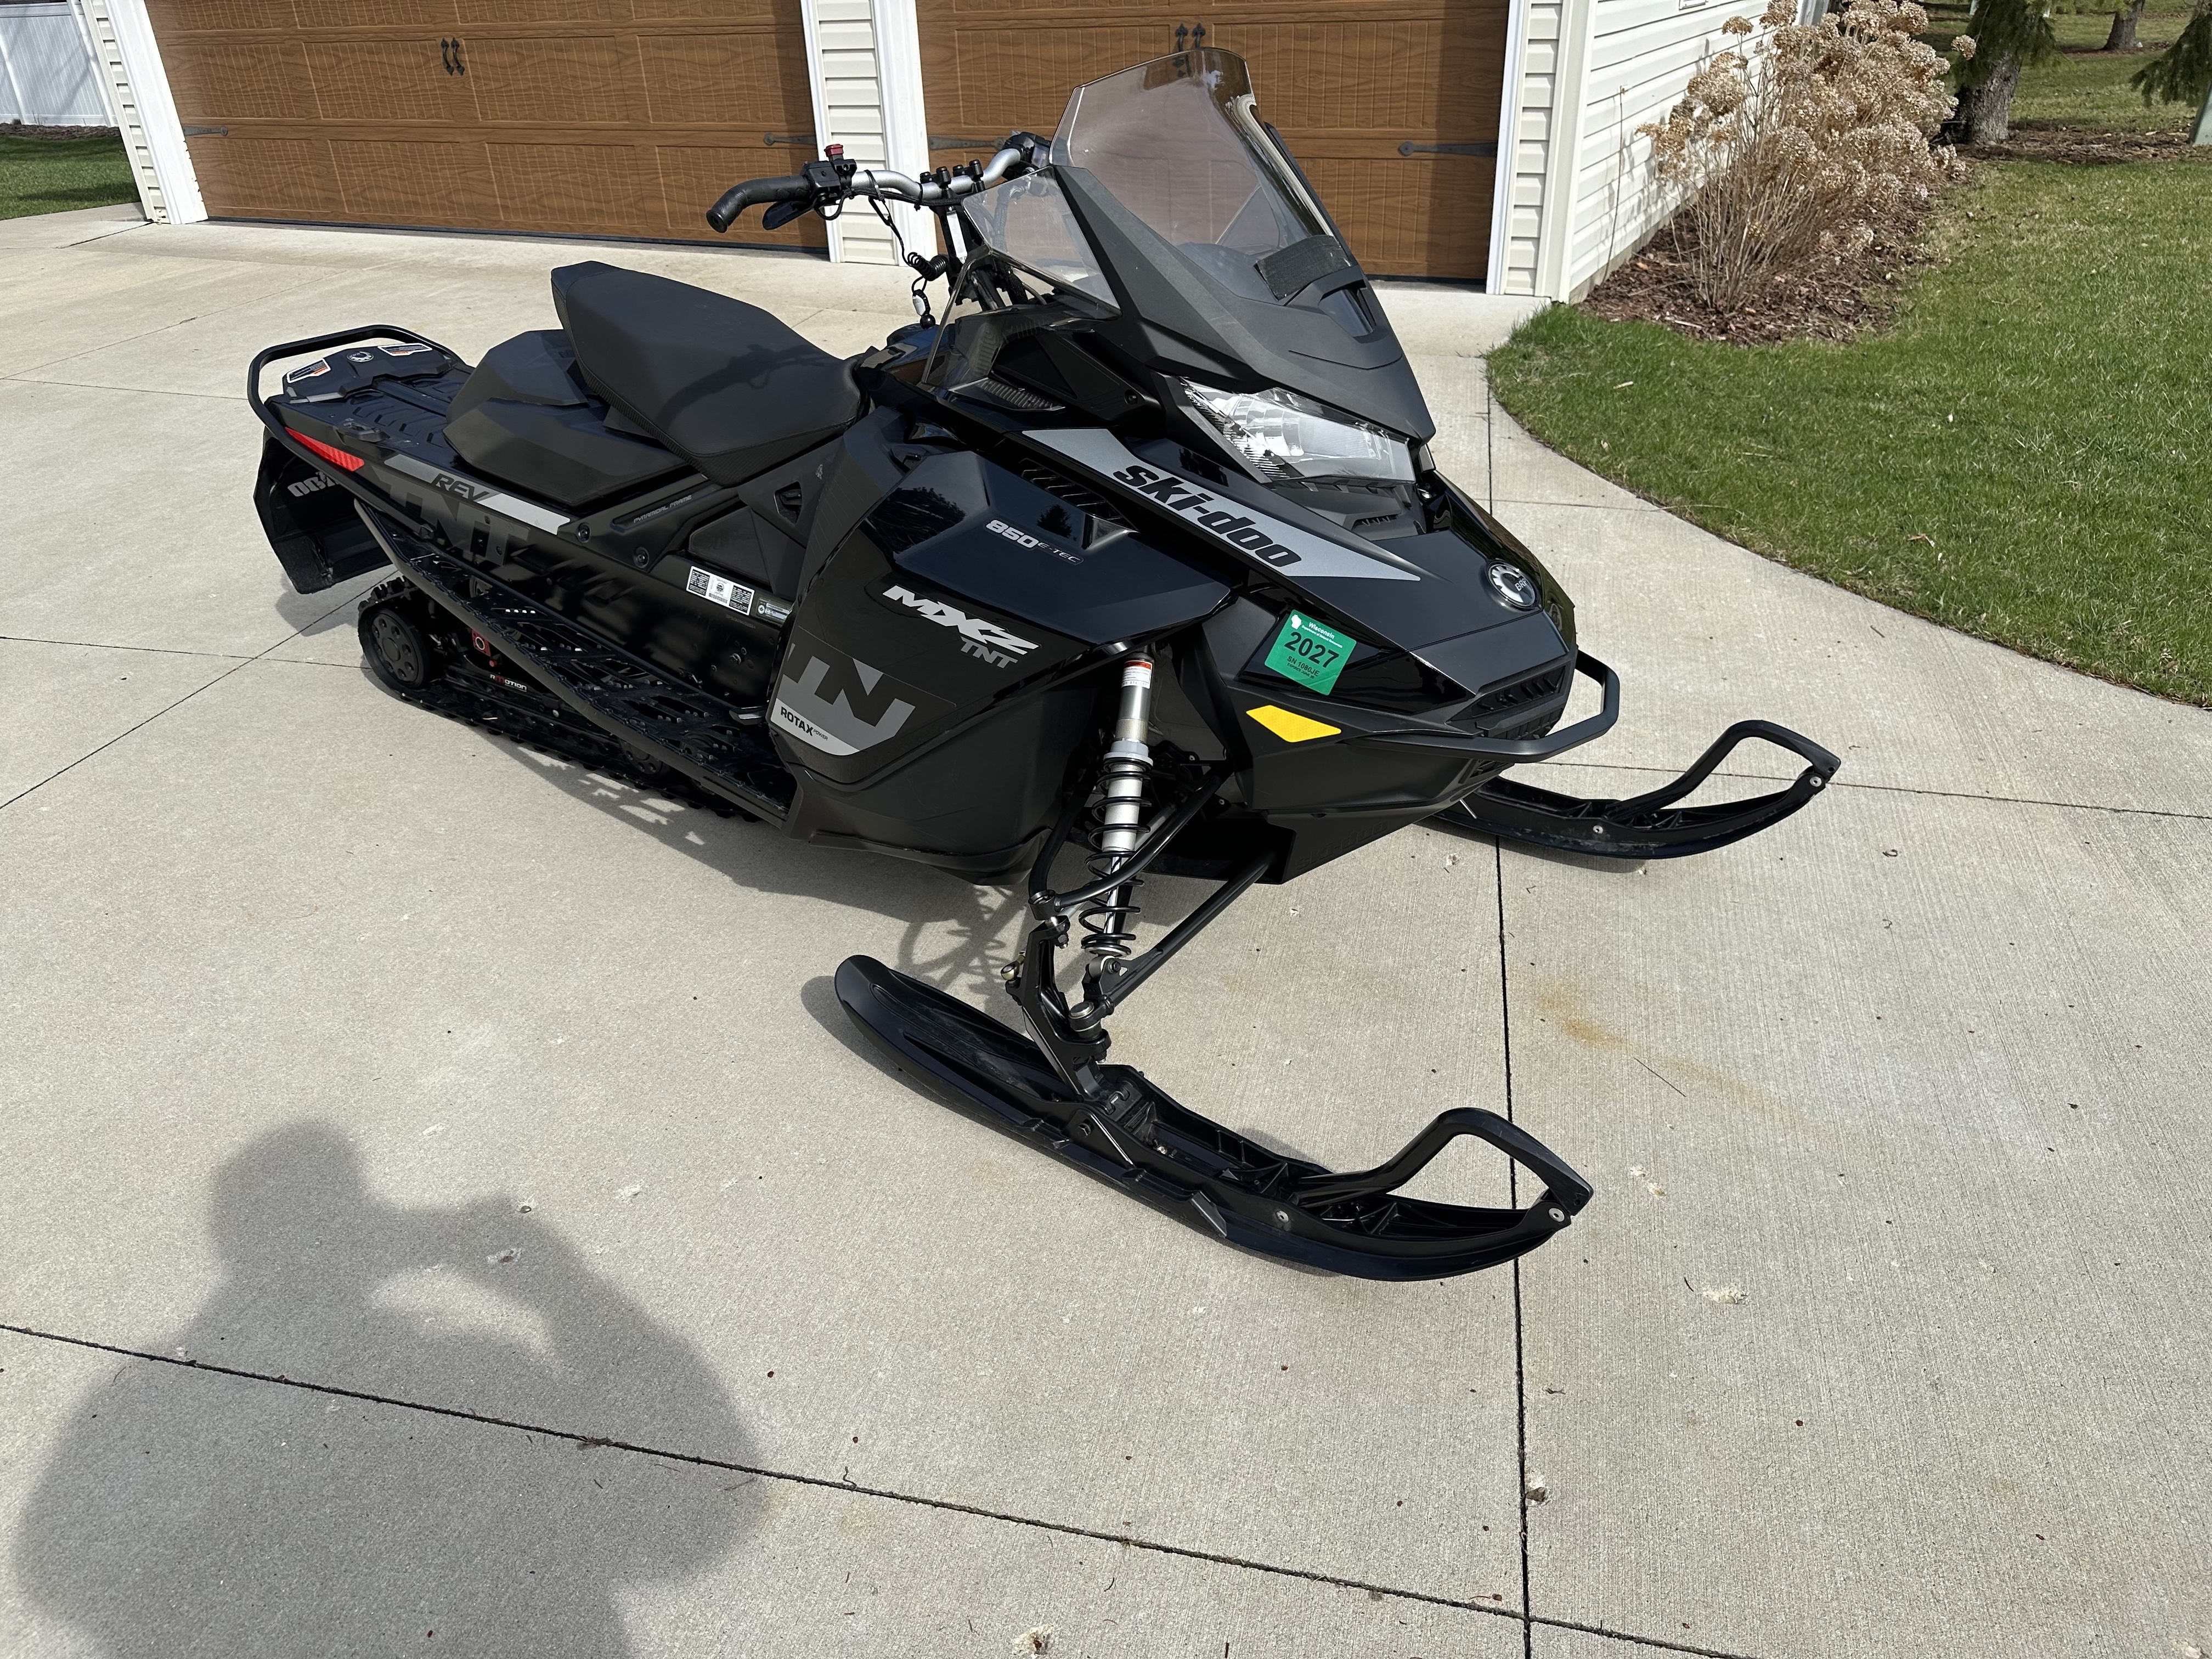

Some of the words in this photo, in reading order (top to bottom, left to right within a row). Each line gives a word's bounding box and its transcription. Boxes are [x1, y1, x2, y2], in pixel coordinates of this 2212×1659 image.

[431, 473, 491, 500] REV
[633, 505, 669, 523] PYRAMIDAL
[669, 494, 692, 508] FRAME
[1113, 465, 1302, 567] ski-doo
[986, 520, 1039, 548] 850
[1037, 542, 1081, 562] E-TEC
[882, 585, 1039, 655] MXZ
[1308, 622, 1335, 639] Wisconsin
[961, 636, 1018, 669] TNT
[1284, 631, 1340, 668] 2027
[1287, 656, 1297, 664] SN
[780, 706, 814, 736] ROTAX
[813, 729, 828, 741] POWER
